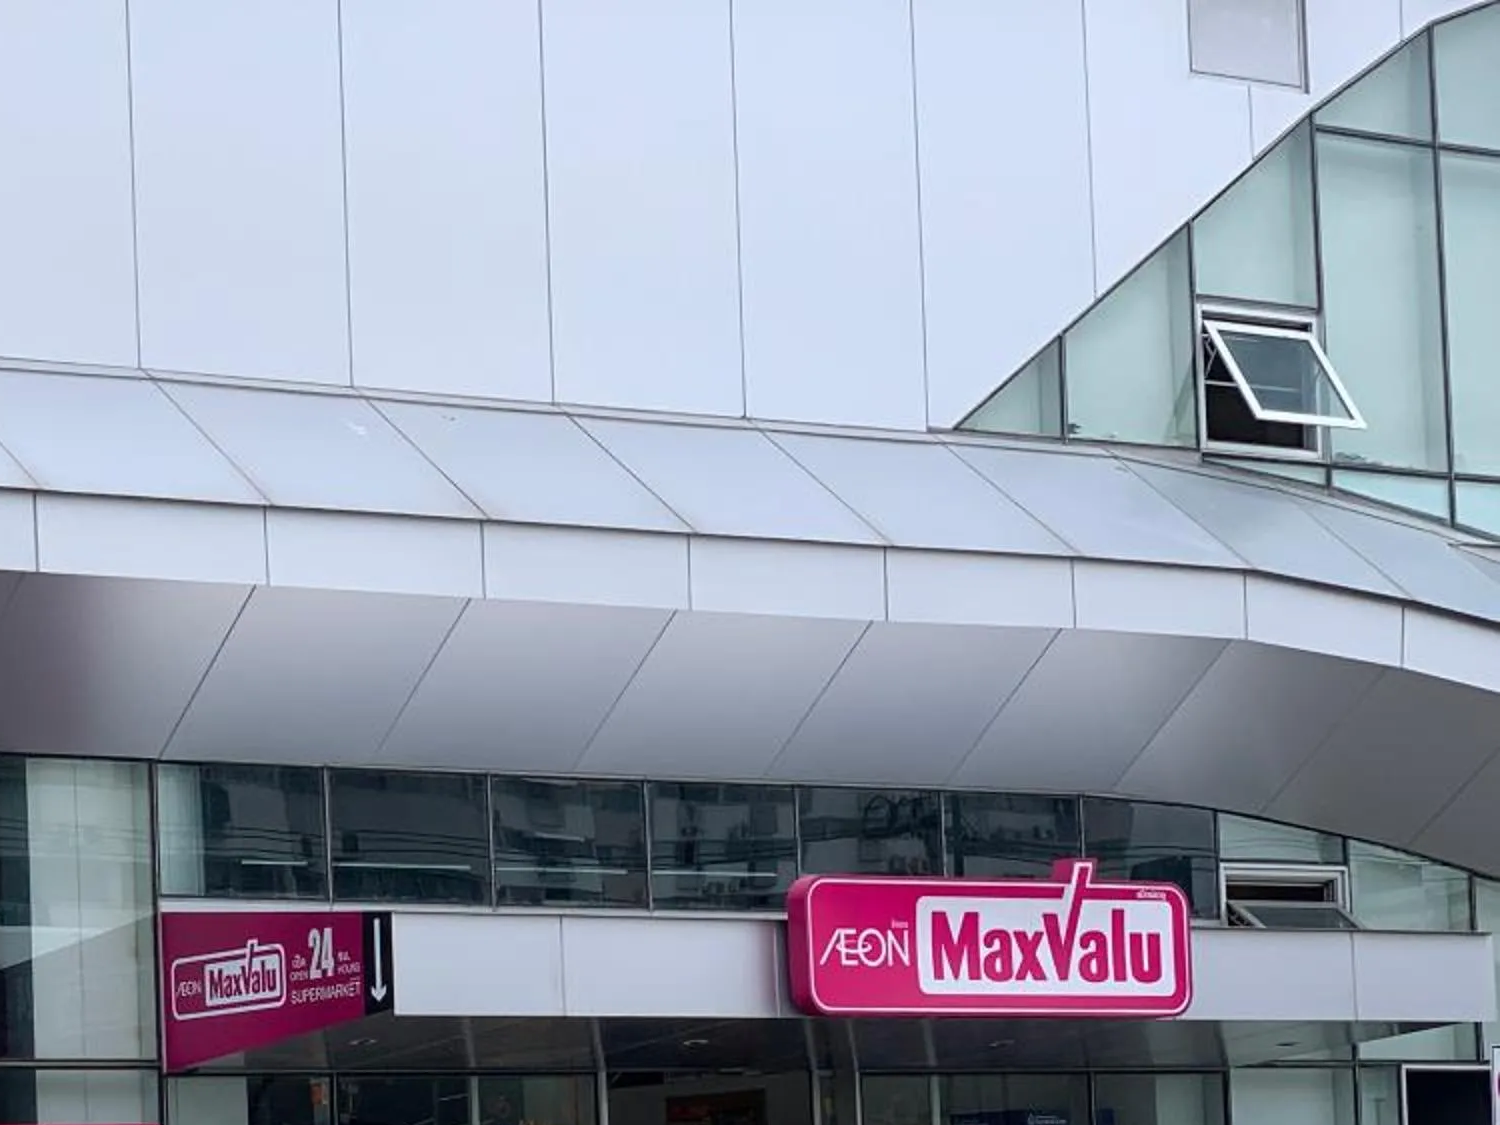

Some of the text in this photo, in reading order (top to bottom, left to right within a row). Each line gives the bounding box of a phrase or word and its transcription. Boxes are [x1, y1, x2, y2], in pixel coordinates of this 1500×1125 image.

[307, 926, 335, 980] 24
[930, 866, 1163, 984] MaxValu
[208, 943, 277, 1001] MaxValu
[290, 981, 361, 1005] SUPERMARKET
